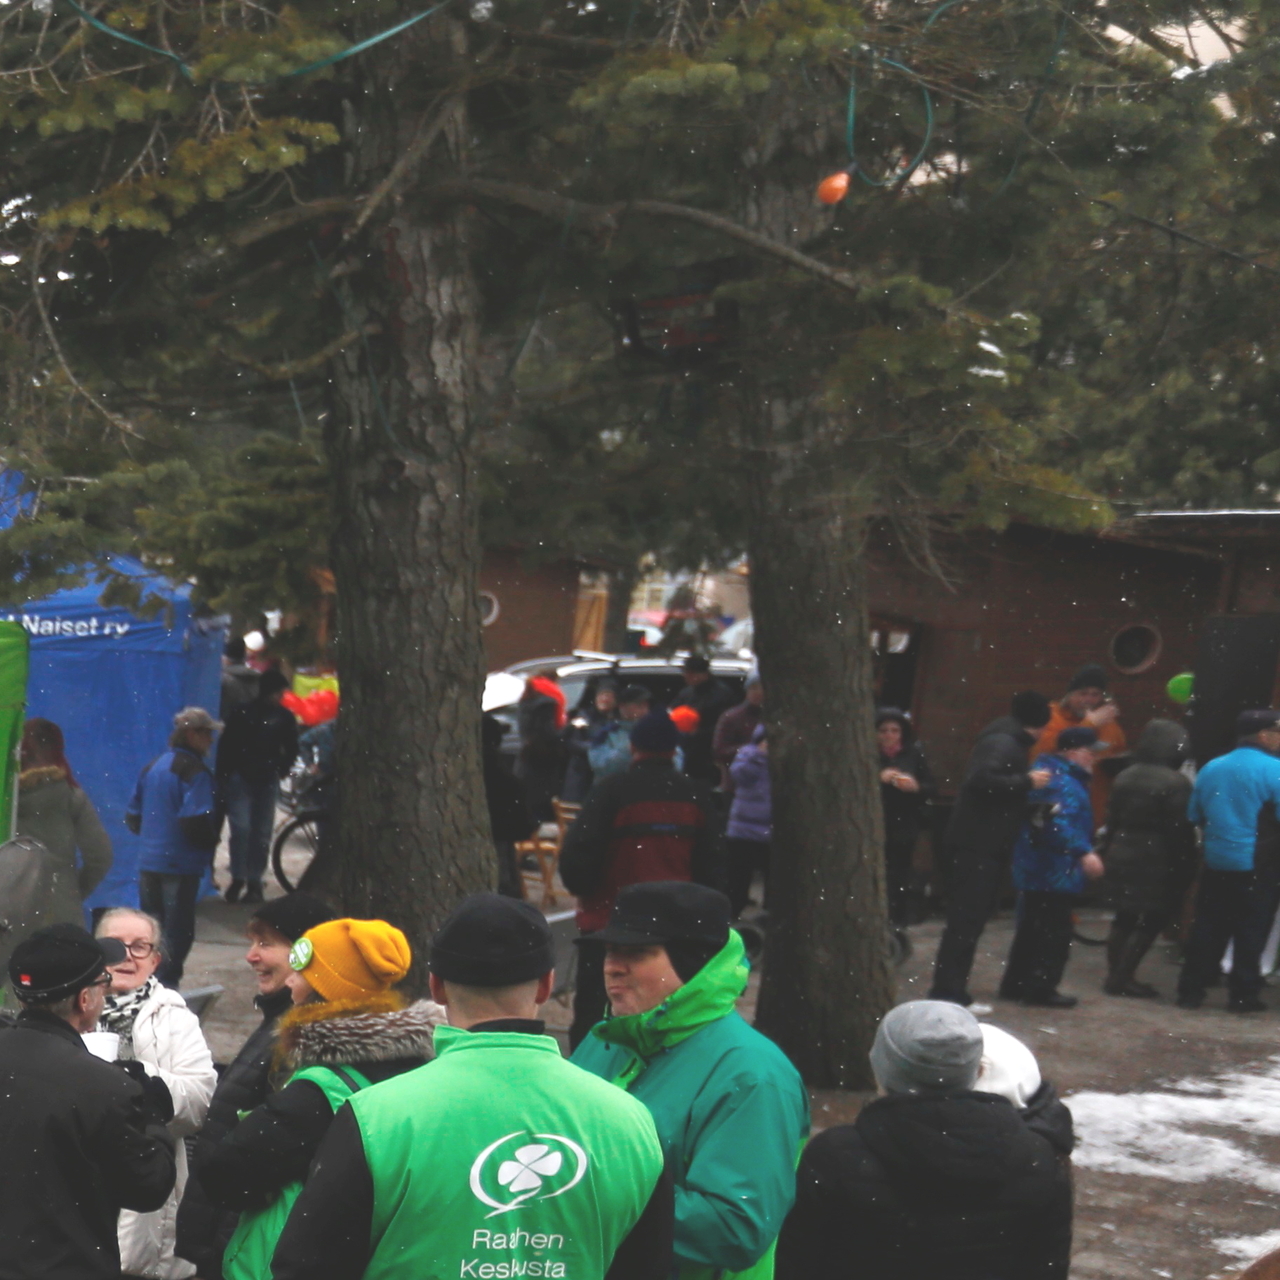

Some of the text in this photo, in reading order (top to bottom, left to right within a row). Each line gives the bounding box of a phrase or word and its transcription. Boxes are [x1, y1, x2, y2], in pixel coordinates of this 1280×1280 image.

[22, 614, 130, 639] Naiset ry
[472, 1226, 564, 1249] Raahen
[460, 1258, 566, 1279] Keskusta
